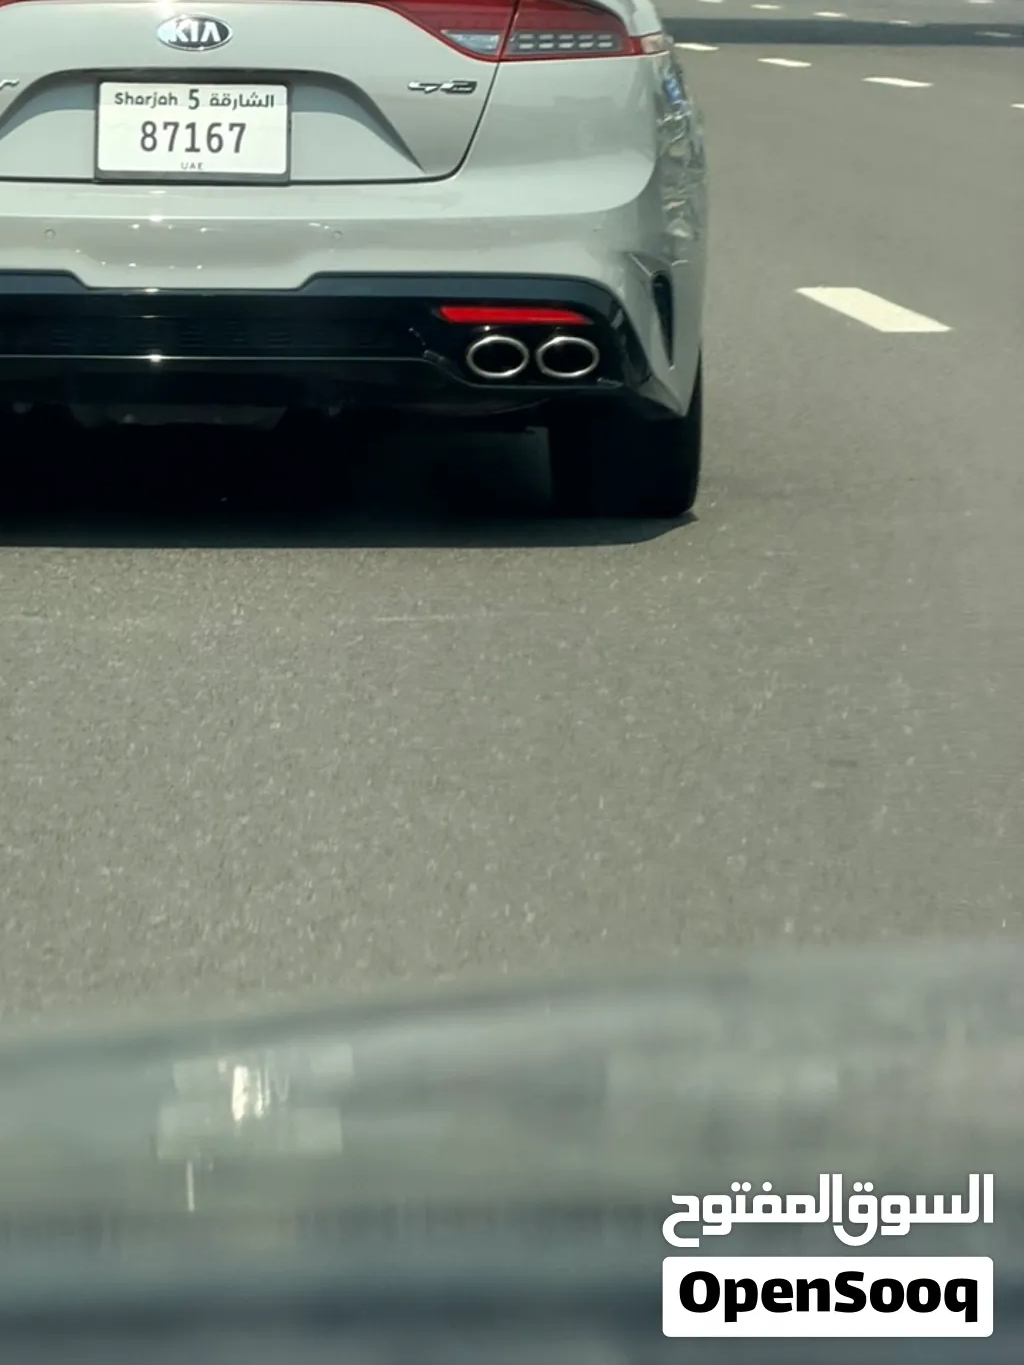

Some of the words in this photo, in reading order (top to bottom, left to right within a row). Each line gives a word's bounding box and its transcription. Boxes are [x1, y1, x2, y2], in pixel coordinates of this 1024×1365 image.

[166, 17, 222, 43] KIA
[114, 90, 179, 109] Sharjah
[187, 88, 201, 111] 5
[208, 90, 275, 111] الشارقة
[139, 119, 247, 154] 87167
[180, 161, 205, 171] UAE
